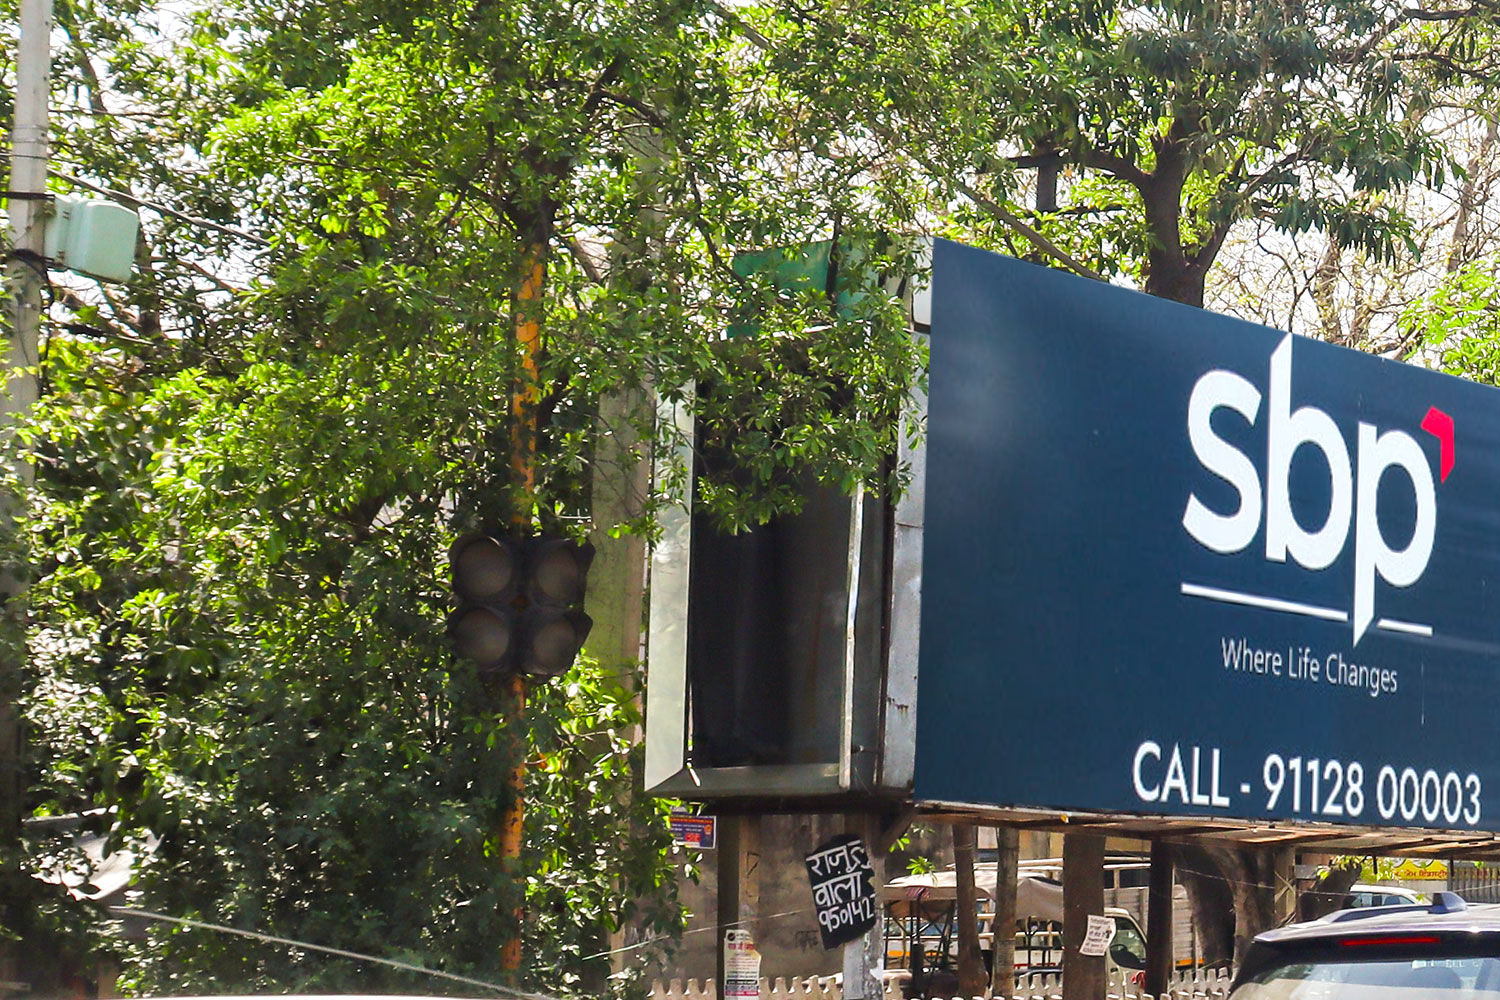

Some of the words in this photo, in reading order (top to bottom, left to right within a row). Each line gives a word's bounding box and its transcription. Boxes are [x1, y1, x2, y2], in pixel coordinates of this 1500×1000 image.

[1182, 331, 1437, 646] sbp
[1221, 638, 1282, 676] Where
[1288, 647, 1320, 682] Life
[1325, 652, 1398, 697] Changes
[1132, 740, 1230, 808] CALL
[1263, 753, 1364, 817] 91128
[1376, 765, 1482, 825] 00003
[813, 871, 863, 908] वाला
[819, 893, 876, 933] 950142
